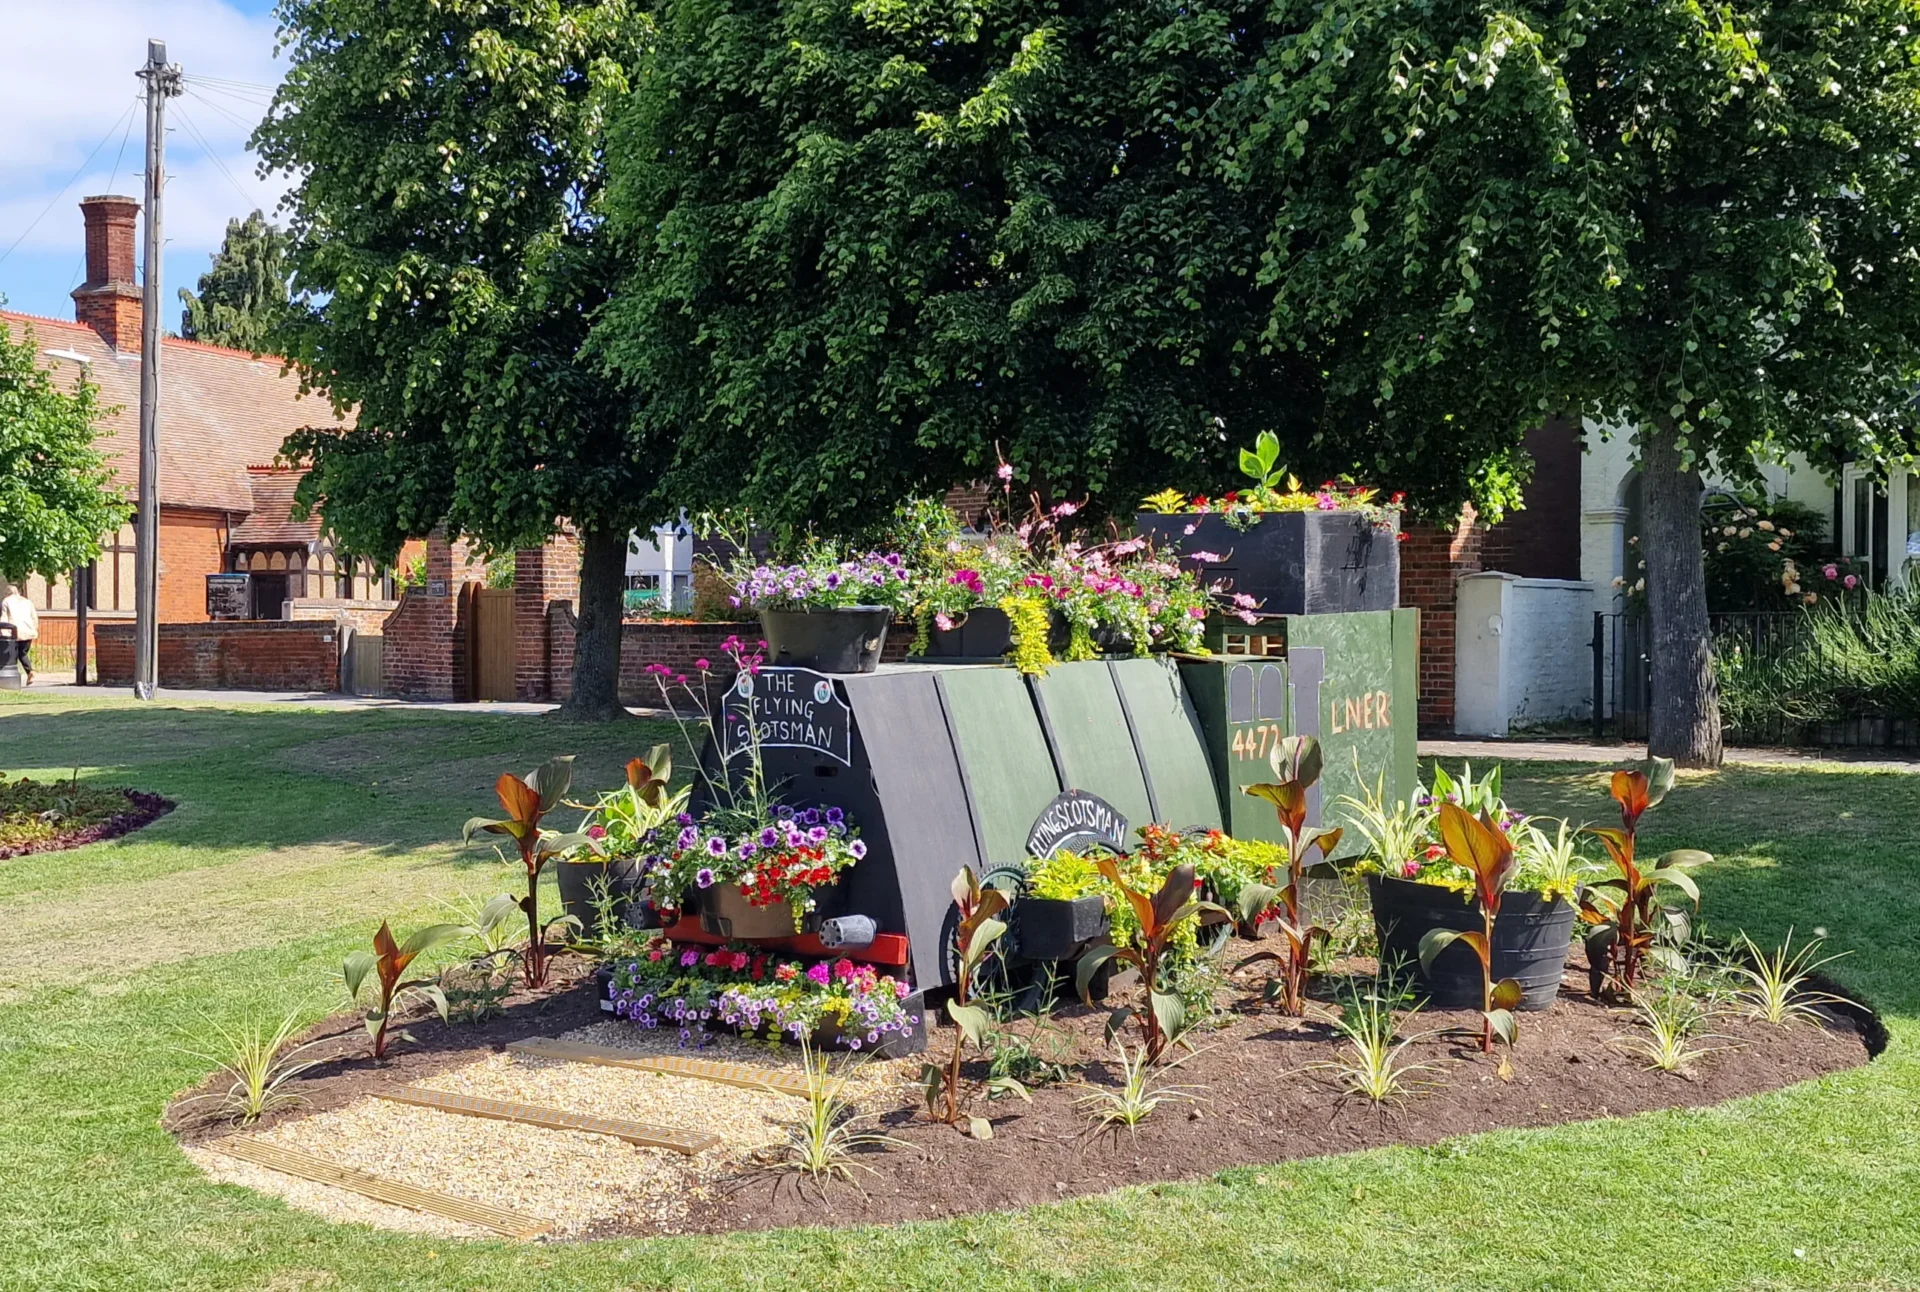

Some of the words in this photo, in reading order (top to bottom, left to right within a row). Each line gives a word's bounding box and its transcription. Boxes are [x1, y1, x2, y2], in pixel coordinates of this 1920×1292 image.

[762, 673, 795, 693] THE
[753, 697, 814, 722] FLYING
[1331, 690, 1391, 735] LNER
[737, 721, 833, 749] SOTSMAN
